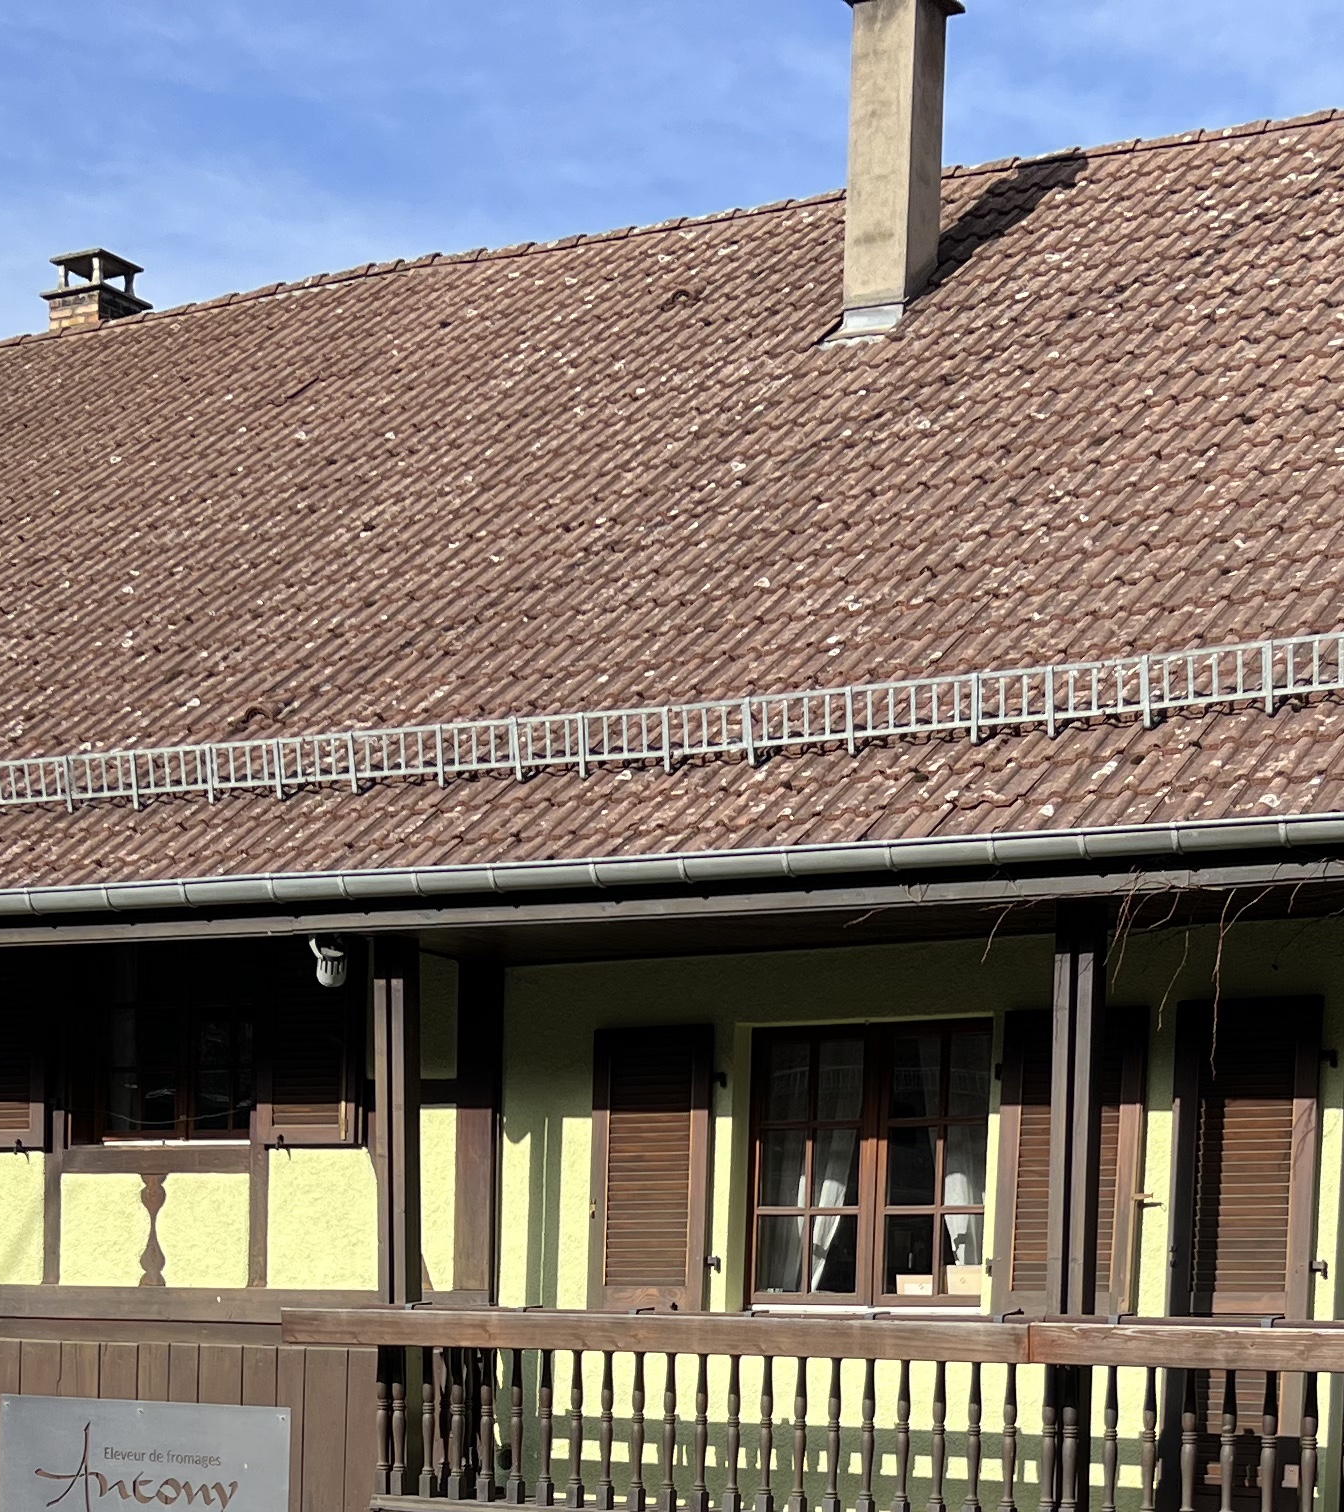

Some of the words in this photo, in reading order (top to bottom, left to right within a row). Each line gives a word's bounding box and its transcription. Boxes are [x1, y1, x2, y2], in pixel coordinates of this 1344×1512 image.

[103, 1446, 146, 1463] Eleveur
[149, 1450, 164, 1464] de
[166, 1451, 222, 1469] fromages
